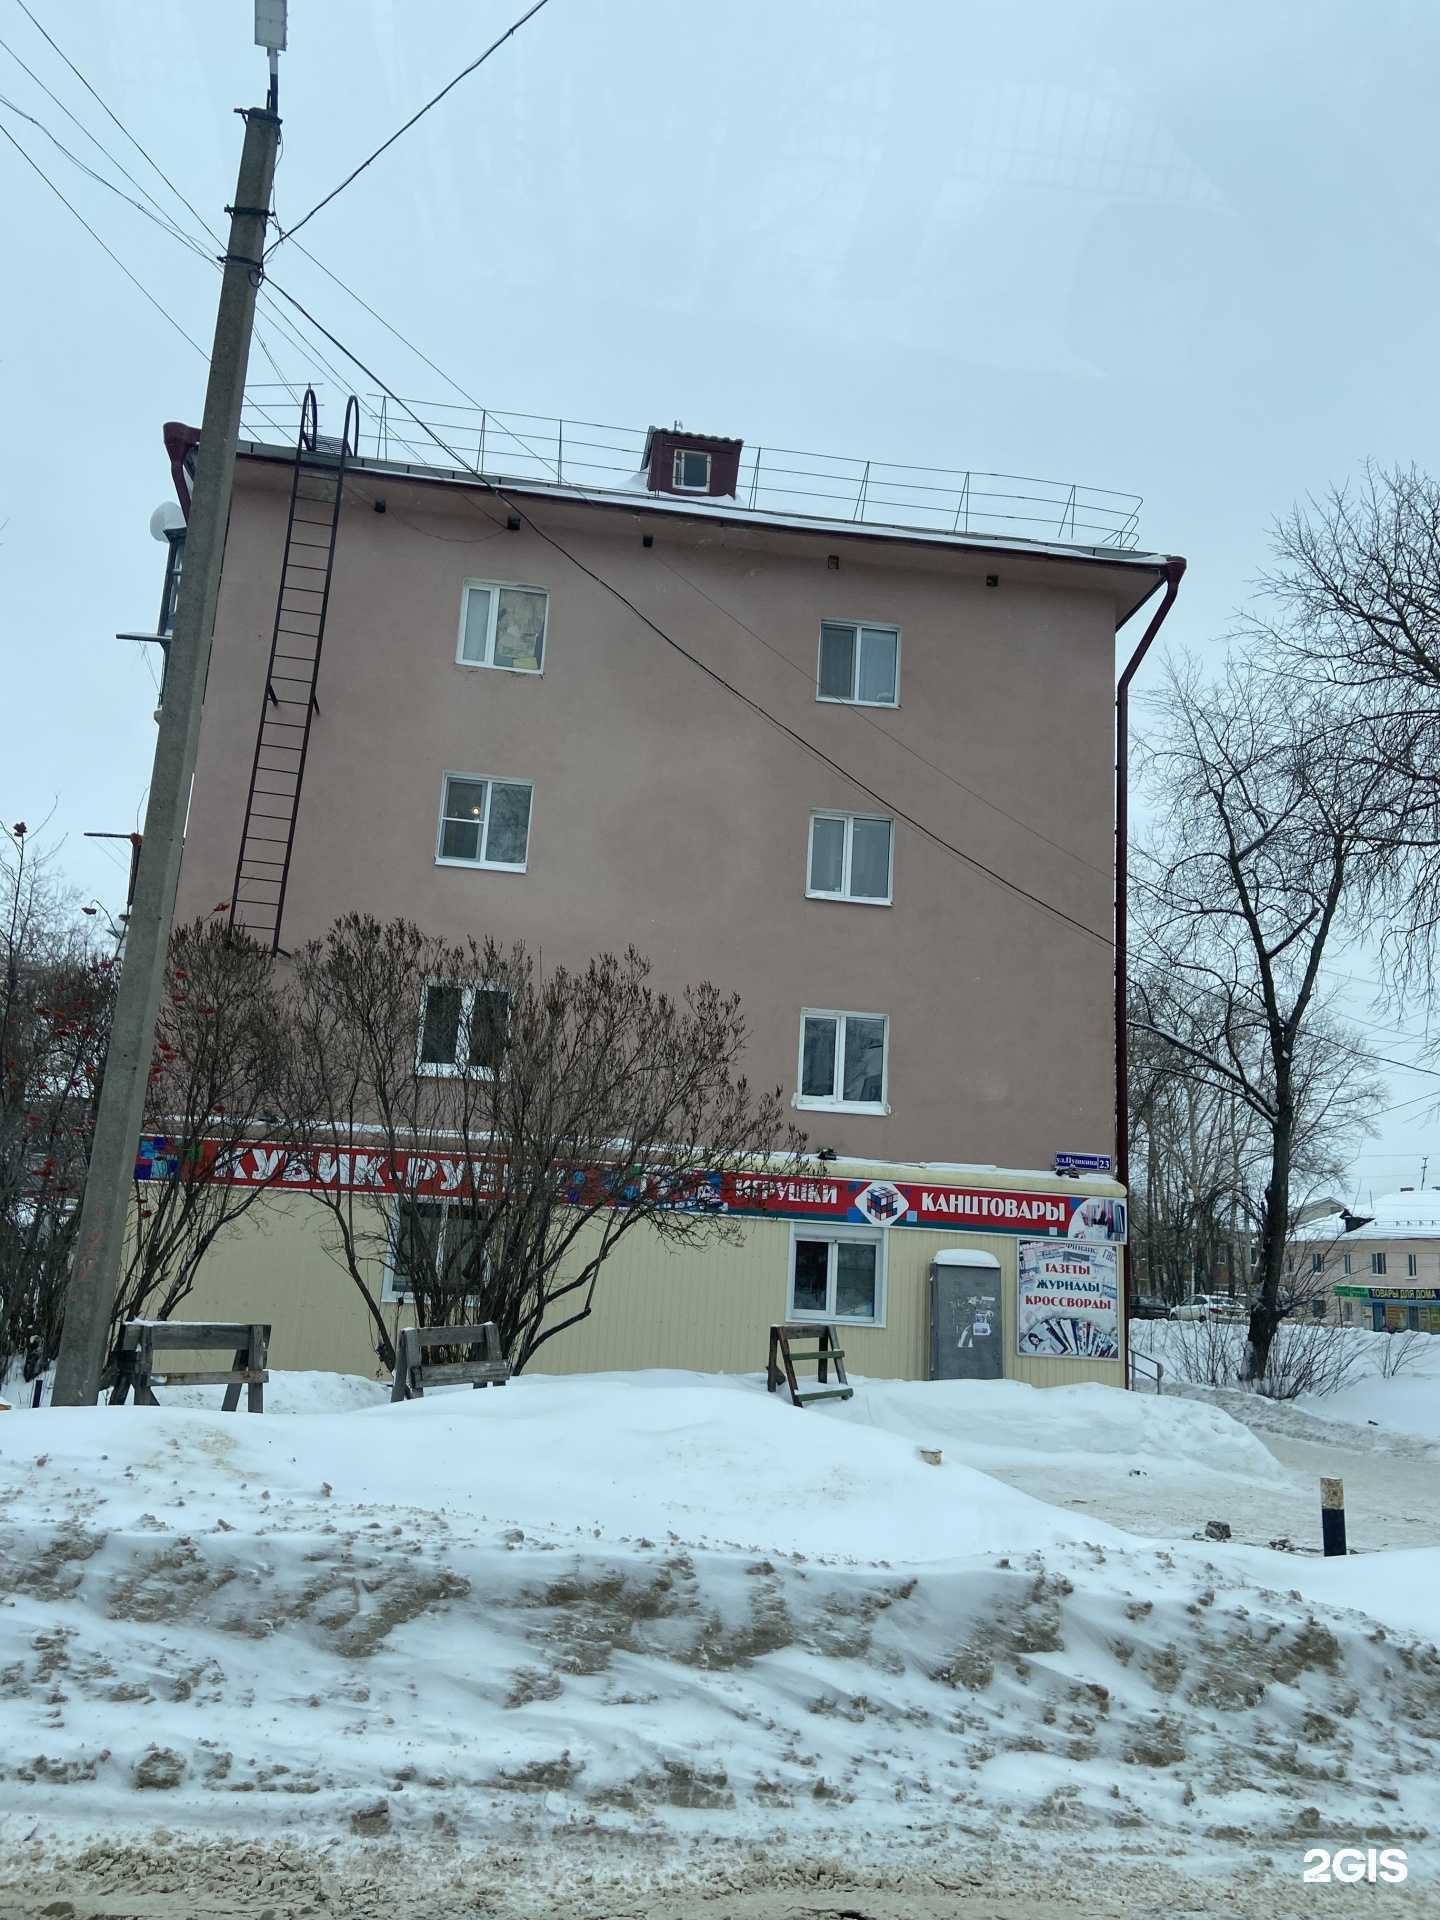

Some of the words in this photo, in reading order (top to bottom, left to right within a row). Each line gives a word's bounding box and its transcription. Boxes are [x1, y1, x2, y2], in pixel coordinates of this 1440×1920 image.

[1099, 1160, 1110, 1169] 23
[735, 1178, 838, 1205] ИГРУШКИ
[921, 1192, 1065, 1221] КАНЦТОВАРЫ
[1045, 1263, 1091, 1275] ГАЗЕТЫ
[1036, 1279, 1100, 1292] ЖУРНАЛЫ
[1371, 1289, 1399, 1298] ТОВАРЫ
[1400, 1289, 1415, 1299] ДЛЯ
[1416, 1290, 1436, 1299] ДОМА
[1025, 1295, 1112, 1309] КРОССВОРДЫ
